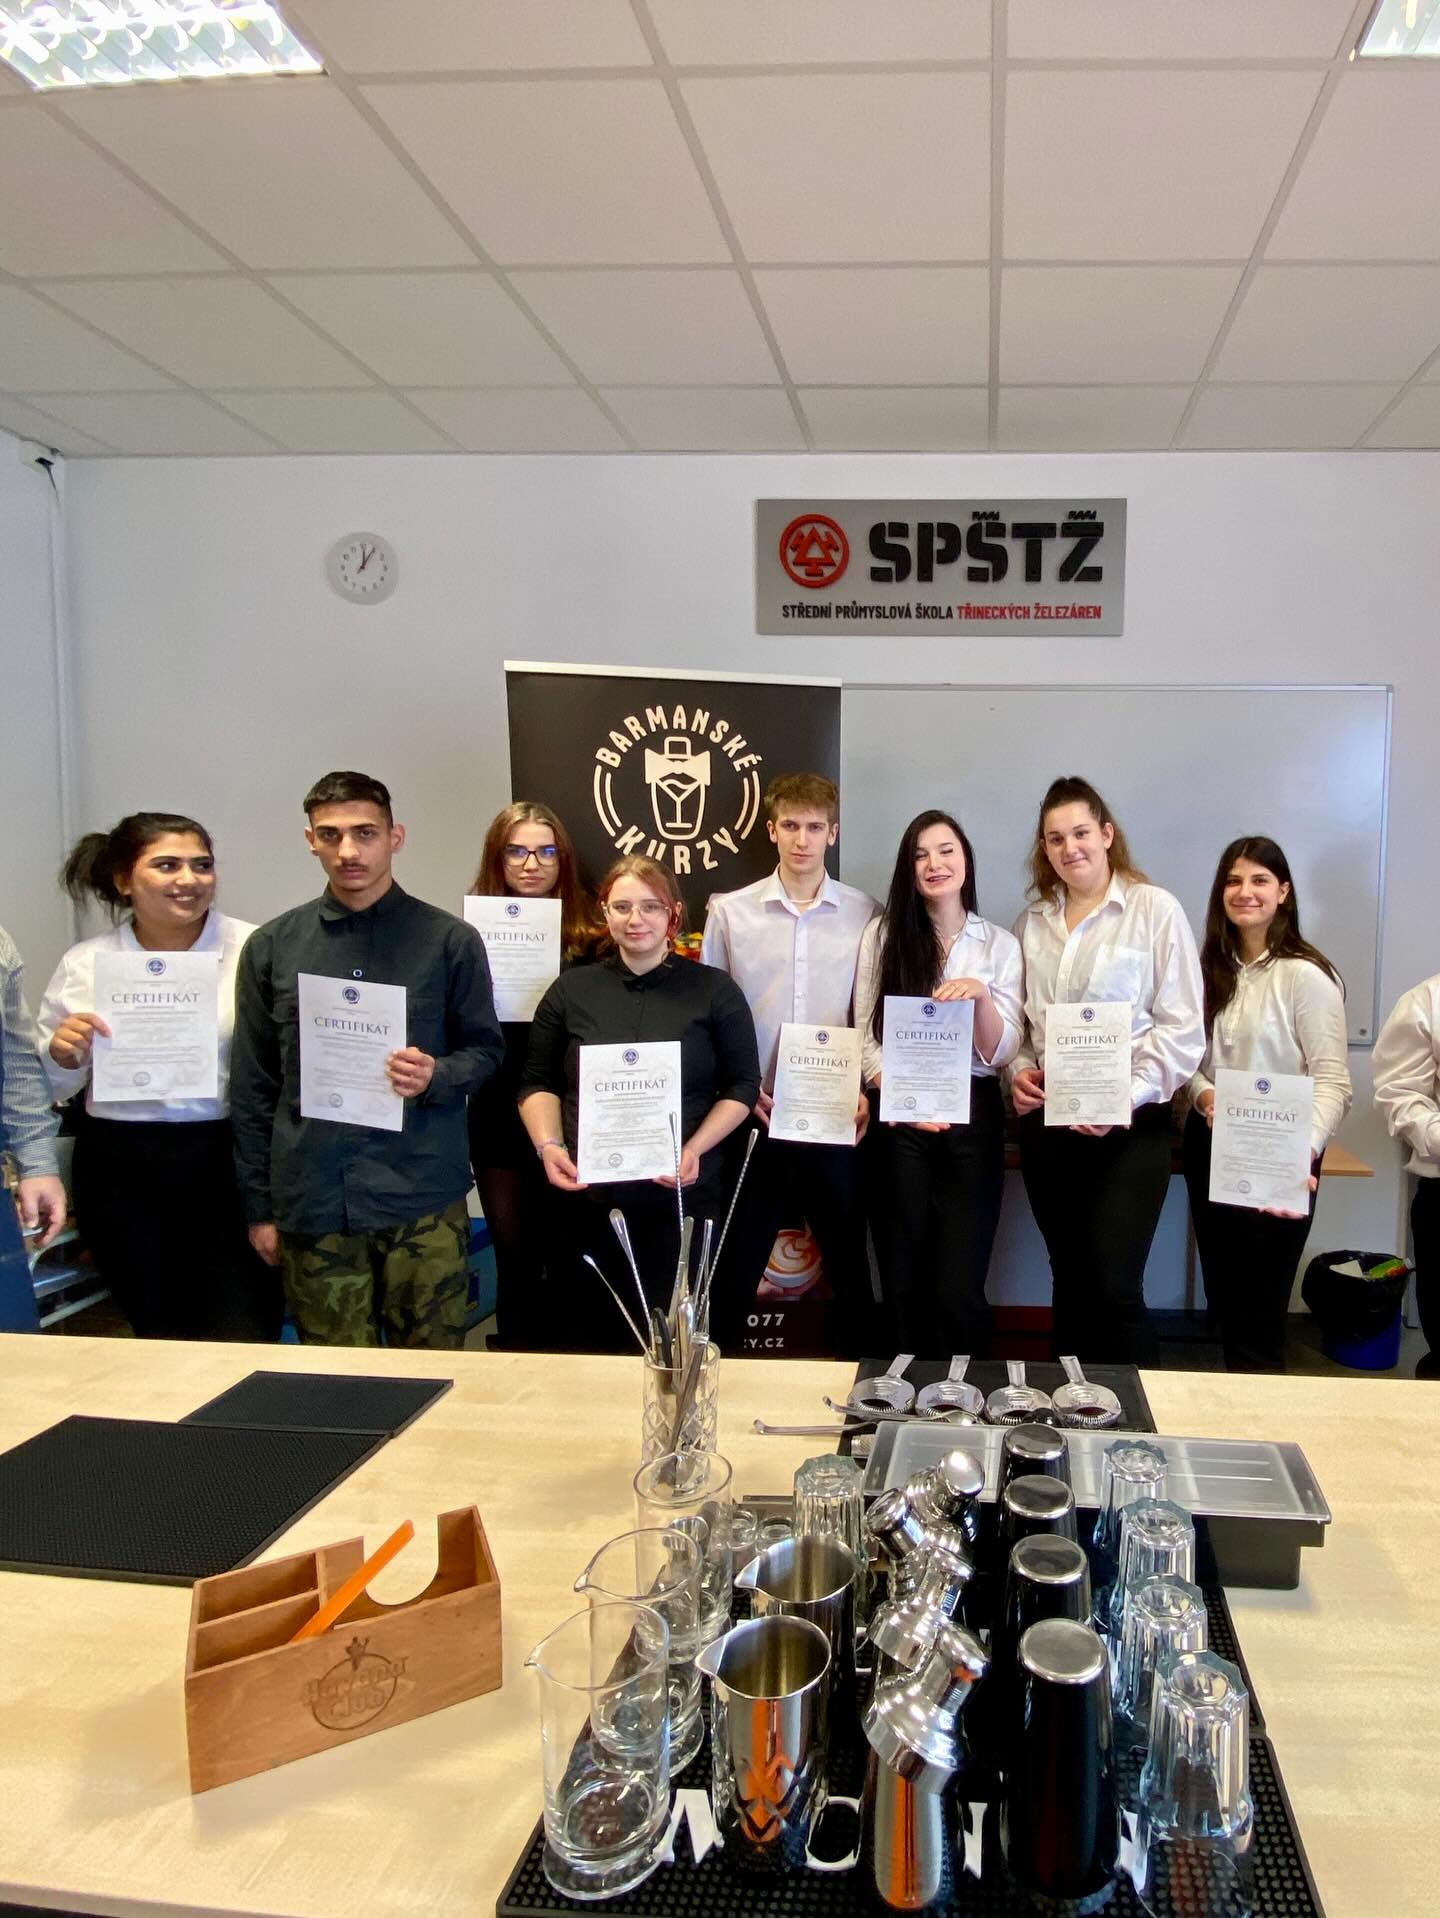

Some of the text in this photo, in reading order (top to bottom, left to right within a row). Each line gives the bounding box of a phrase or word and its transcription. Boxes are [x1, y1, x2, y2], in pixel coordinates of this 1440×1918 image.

[868, 510, 1105, 583] SPŠTŽ
[782, 600, 1102, 620] STŘEDNÍ PRŮMYSLOVÁ ŠKOLA TŘINECKÝCH ŽELEZÁREN
[595, 704, 763, 773] BARMANSKÉ
[614, 824, 740, 875] KURZY
[743, 1337, 785, 1349] Y.CZ
